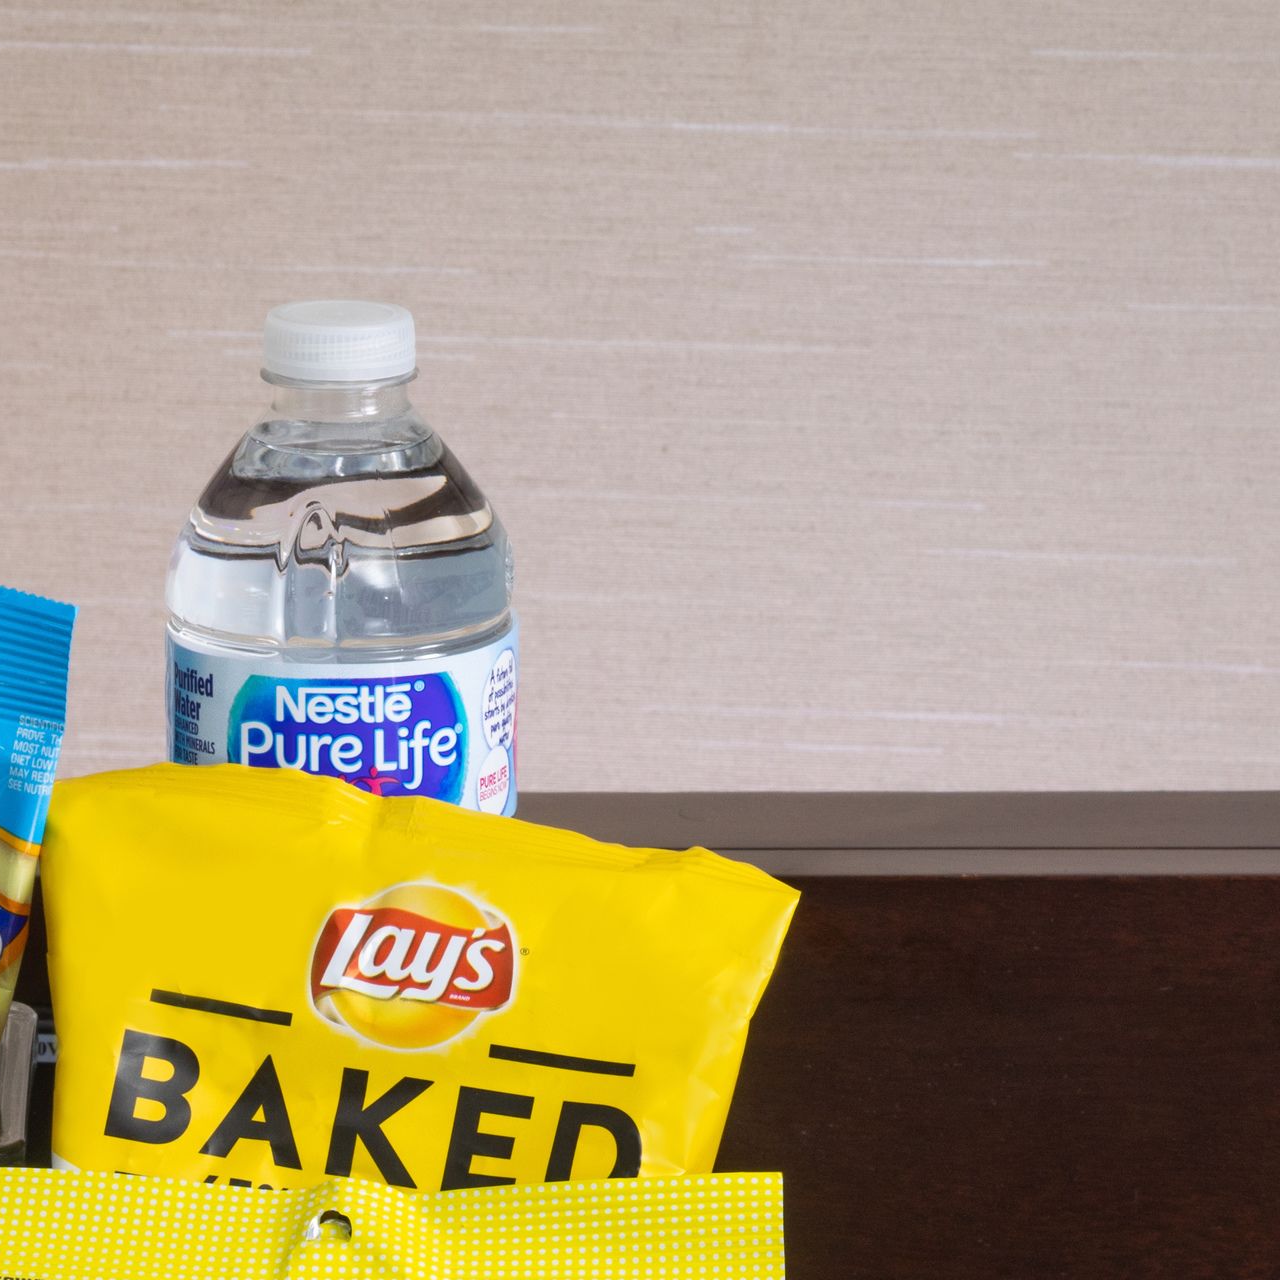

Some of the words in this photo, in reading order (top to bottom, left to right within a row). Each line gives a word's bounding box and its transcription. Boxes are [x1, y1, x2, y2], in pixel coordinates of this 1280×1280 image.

[175, 662, 214, 698] Purified
[175, 688, 201, 720] Water
[13, 740, 40, 755] MOST
[41, 745, 61, 758] NUT
[240, 720, 363, 773] Pure
[373, 722, 458, 791] Life
[7, 778, 23, 792] SEE
[9, 766, 30, 779] MAY
[479, 775, 496, 791] PURE
[496, 765, 508, 783] LIFE
[320, 911, 506, 1003] Lay's
[103, 1028, 645, 1193] BAKED
